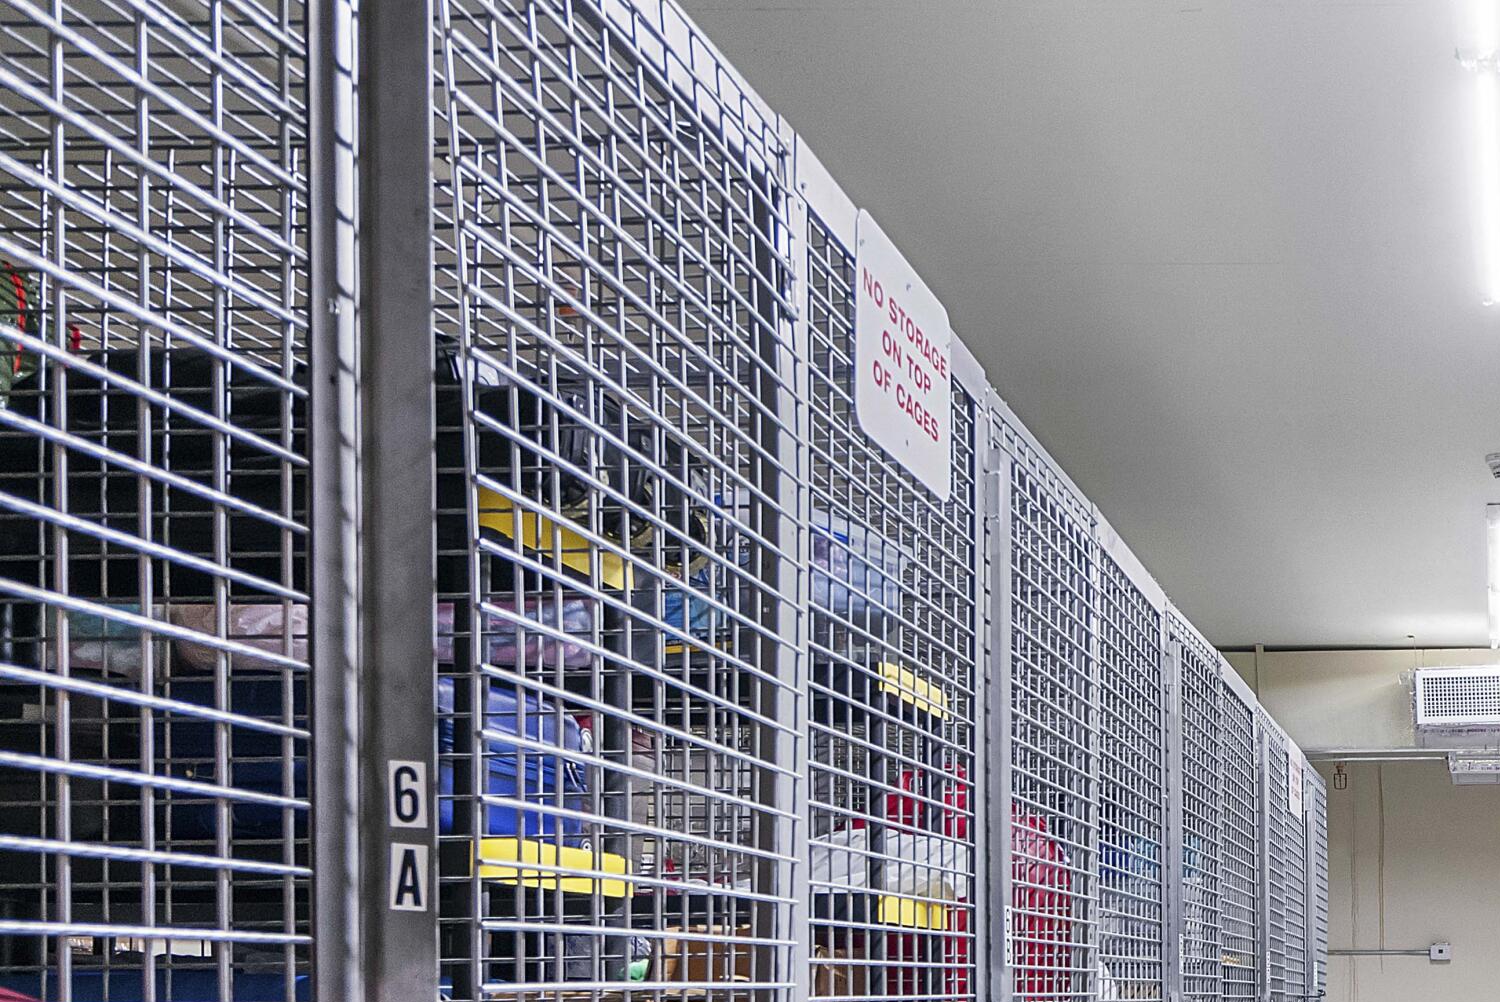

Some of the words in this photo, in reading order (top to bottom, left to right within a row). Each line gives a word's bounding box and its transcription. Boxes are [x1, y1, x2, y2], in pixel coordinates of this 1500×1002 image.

[863, 266, 884, 308] NO
[888, 296, 947, 381] STORAGE
[882, 330, 902, 369] ON
[907, 354, 932, 395] TOP
[873, 359, 892, 394] OF
[896, 383, 939, 442] CAGES
